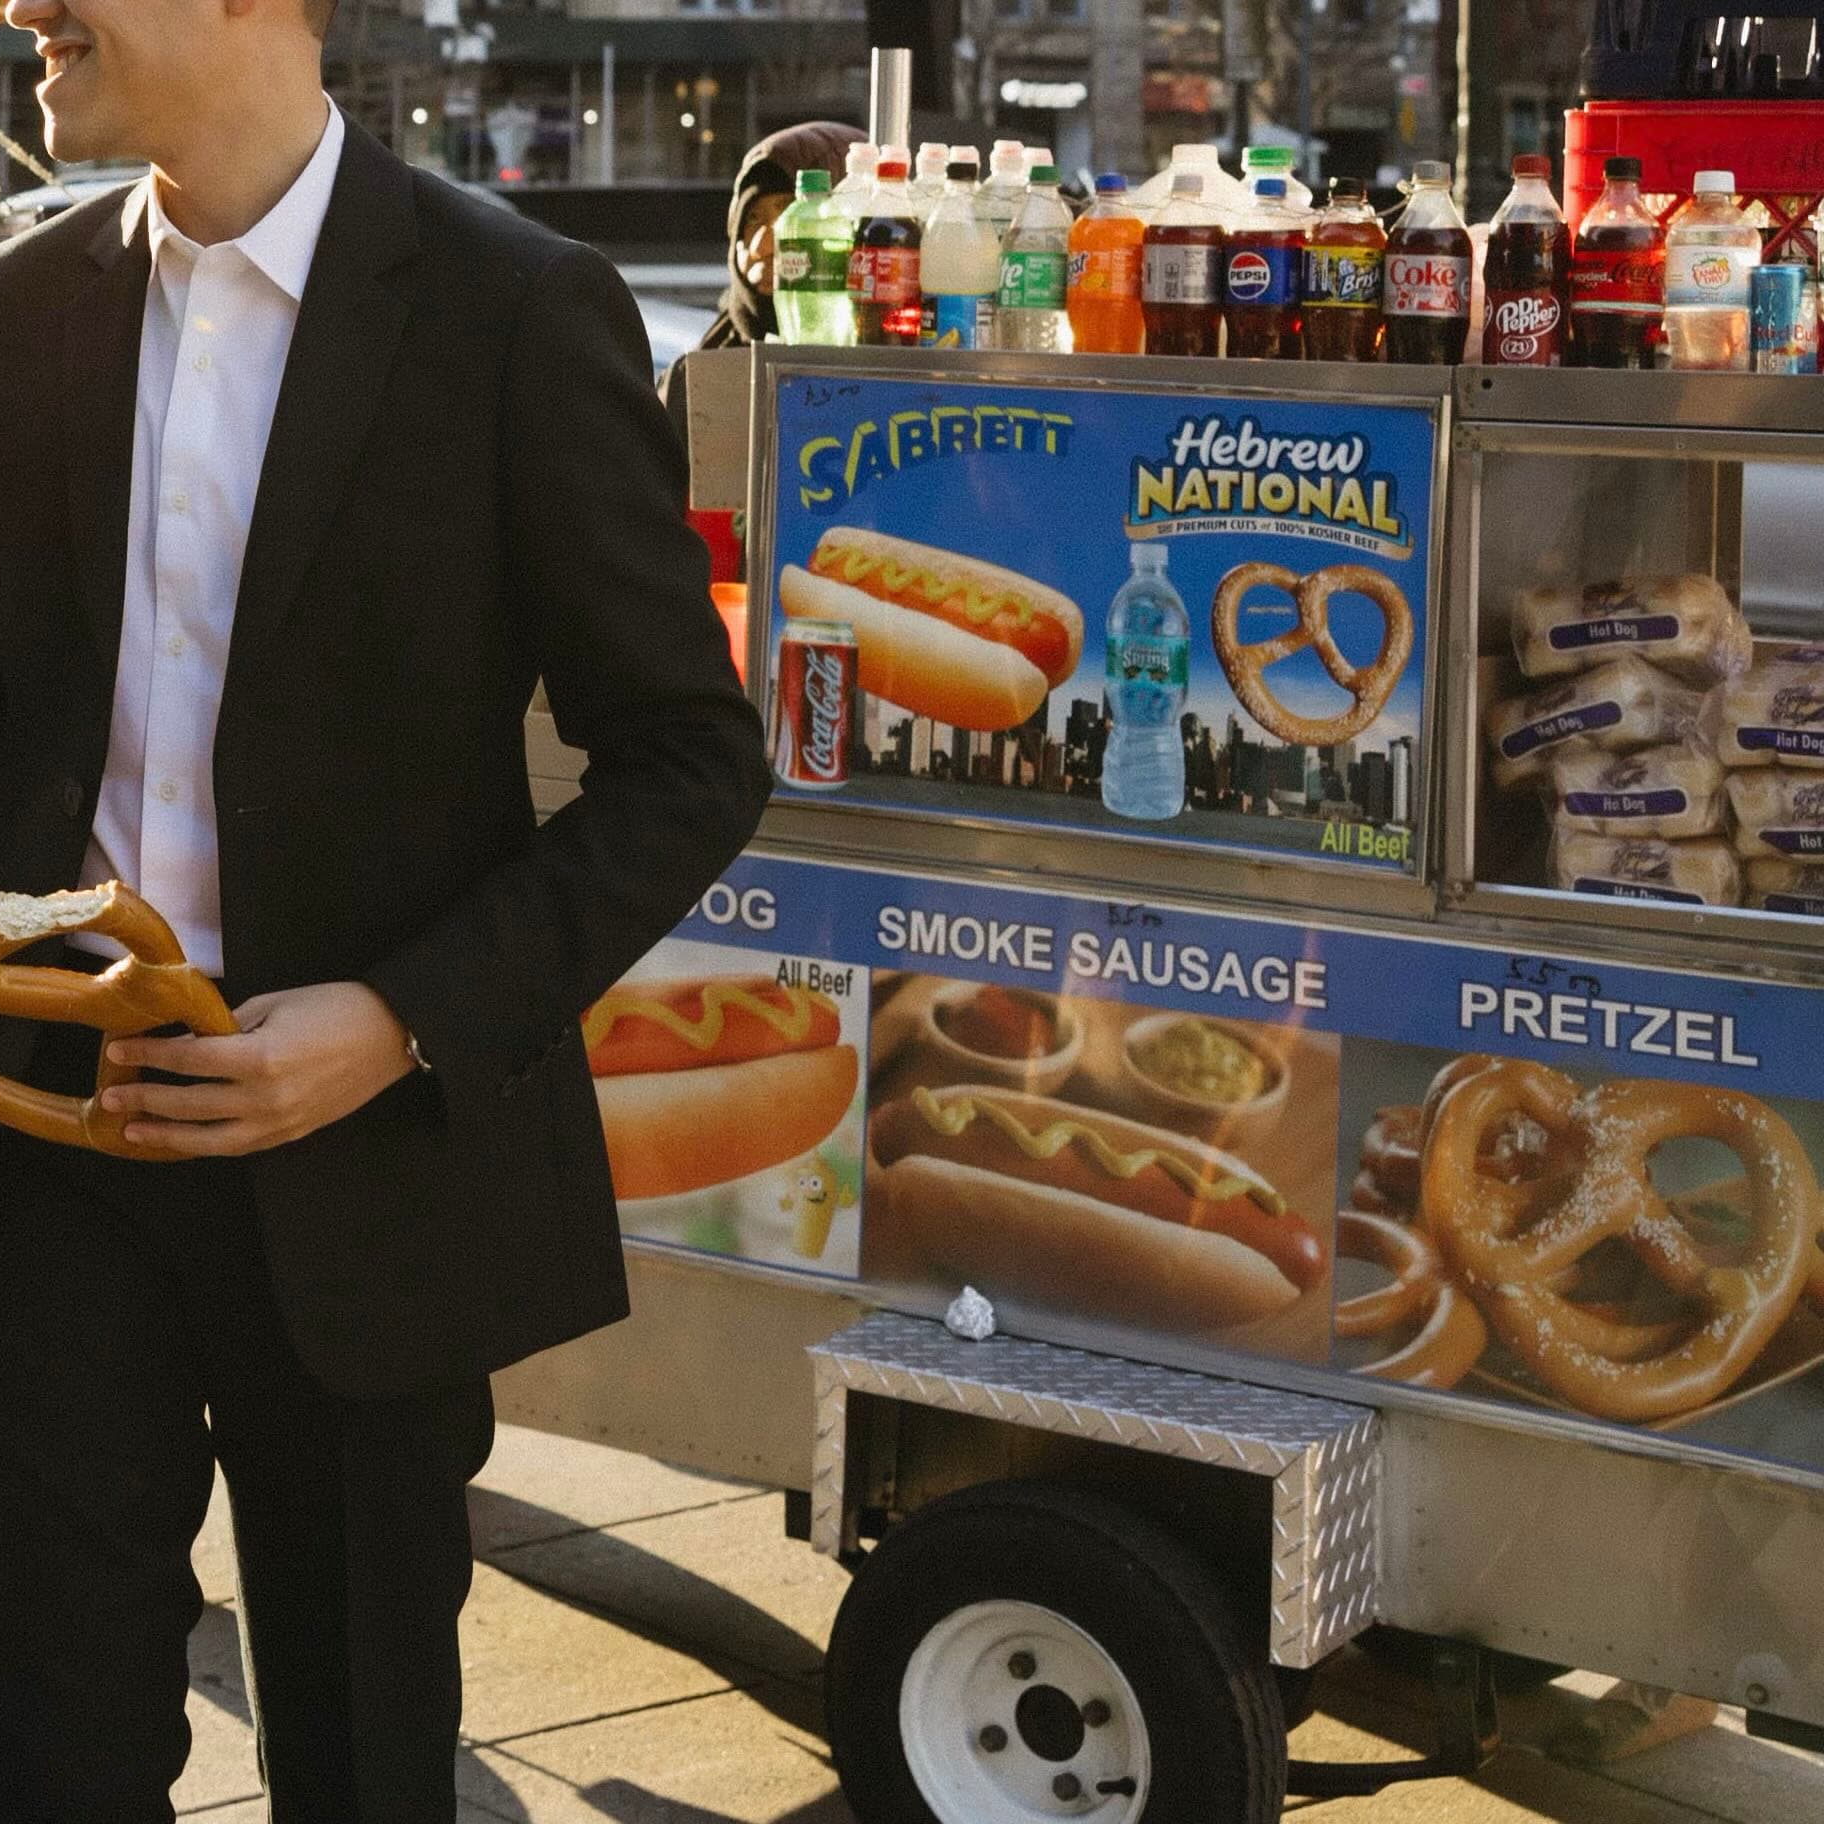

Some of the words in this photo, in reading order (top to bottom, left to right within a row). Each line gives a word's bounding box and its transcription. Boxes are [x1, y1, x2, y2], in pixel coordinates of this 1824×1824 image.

[1230, 270, 1267, 281] PEPSI
[1389, 257, 1457, 287] Coke
[1500, 302, 1556, 335] Pepper
[1517, 297, 1543, 316] Dr
[1511, 340, 1525, 354] 23
[799, 404, 1073, 517] SABRETT
[1172, 418, 1364, 475] Hebrew
[1138, 465, 1399, 536] NATIONAL
[1176, 519, 1227, 533] PREMIUM
[1230, 519, 1258, 532] CUTS
[1275, 522, 1306, 536] 100%
[1308, 525, 1352, 544] KOSHER
[1354, 533, 1380, 551] BEEF
[1589, 623, 1611, 639] Hot
[1614, 622, 1639, 640] Dog
[1558, 717, 1584, 732] Dog
[1776, 732, 1798, 749] Hot
[1603, 796, 1620, 812] Ho
[1623, 796, 1646, 813] Dog
[1320, 821, 1352, 854] All
[1358, 824, 1411, 861] Beef
[685, 882, 776, 931] OG
[877, 905, 1054, 971] SMOKE
[1068, 931, 1328, 1009] SAUSAGE
[776, 958, 802, 989] All
[808, 963, 854, 997] Beef
[1460, 982, 1759, 1068] PRETZEL
